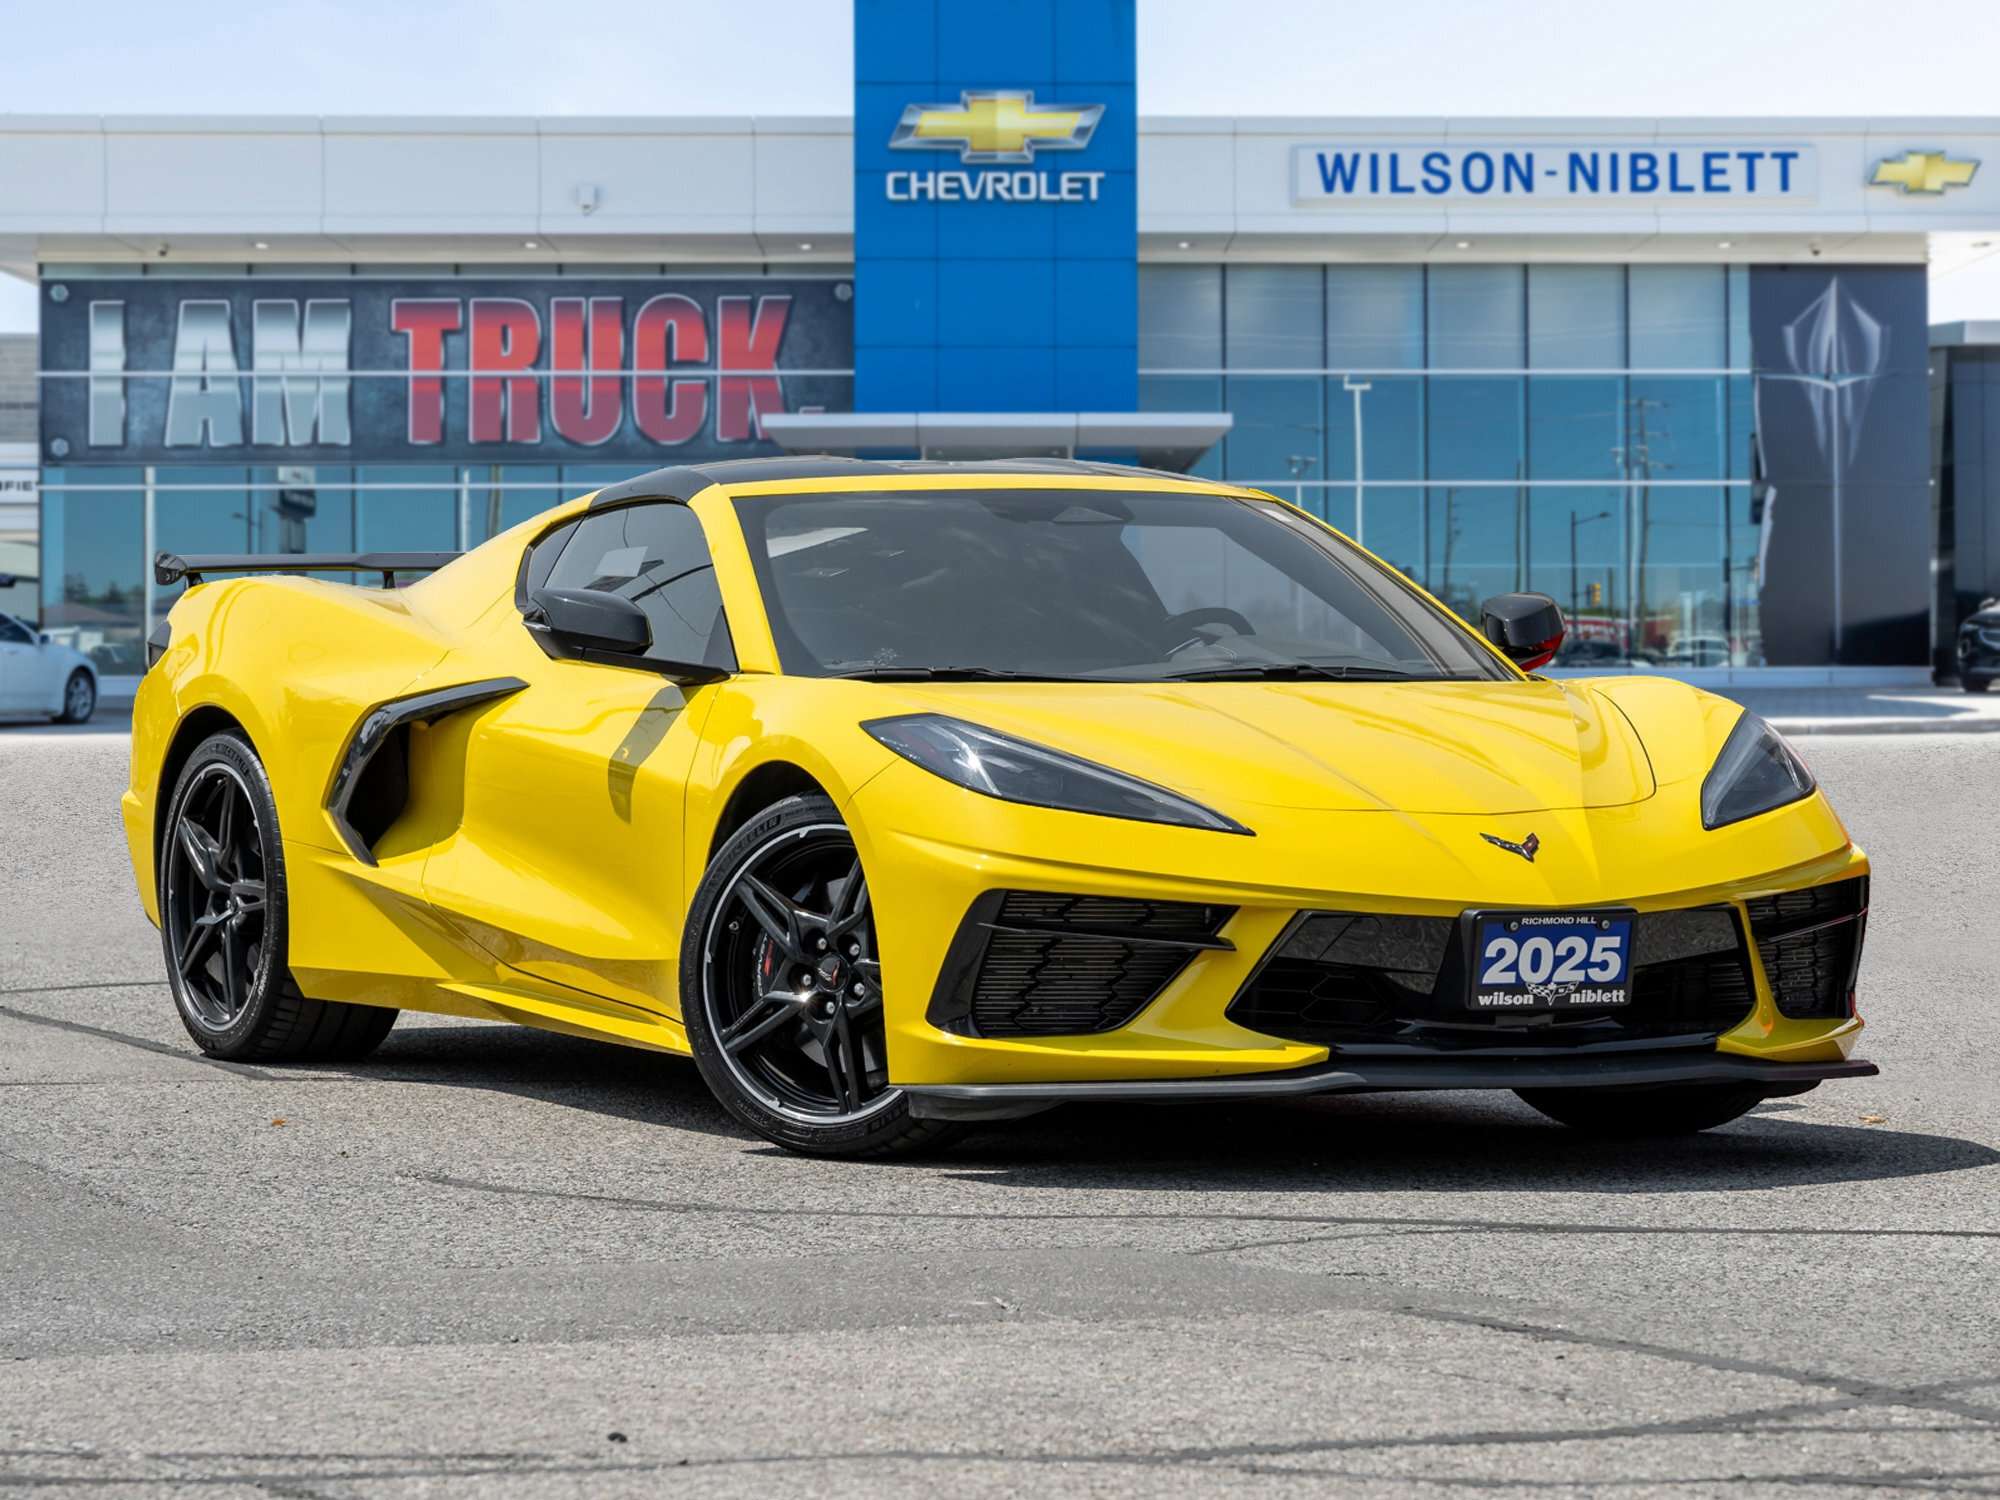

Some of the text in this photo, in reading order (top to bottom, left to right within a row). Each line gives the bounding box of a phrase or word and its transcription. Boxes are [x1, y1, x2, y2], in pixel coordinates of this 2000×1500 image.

[886, 171, 1105, 201] CHEVROLET
[1316, 152, 1800, 194] WILSON-NIBLETT
[89, 293, 822, 446] I AM TRUCK
[1521, 916, 1597, 926] RICHMOND HILL
[1482, 936, 1622, 984] 2025
[1478, 989, 1626, 1006] wilson niblett
